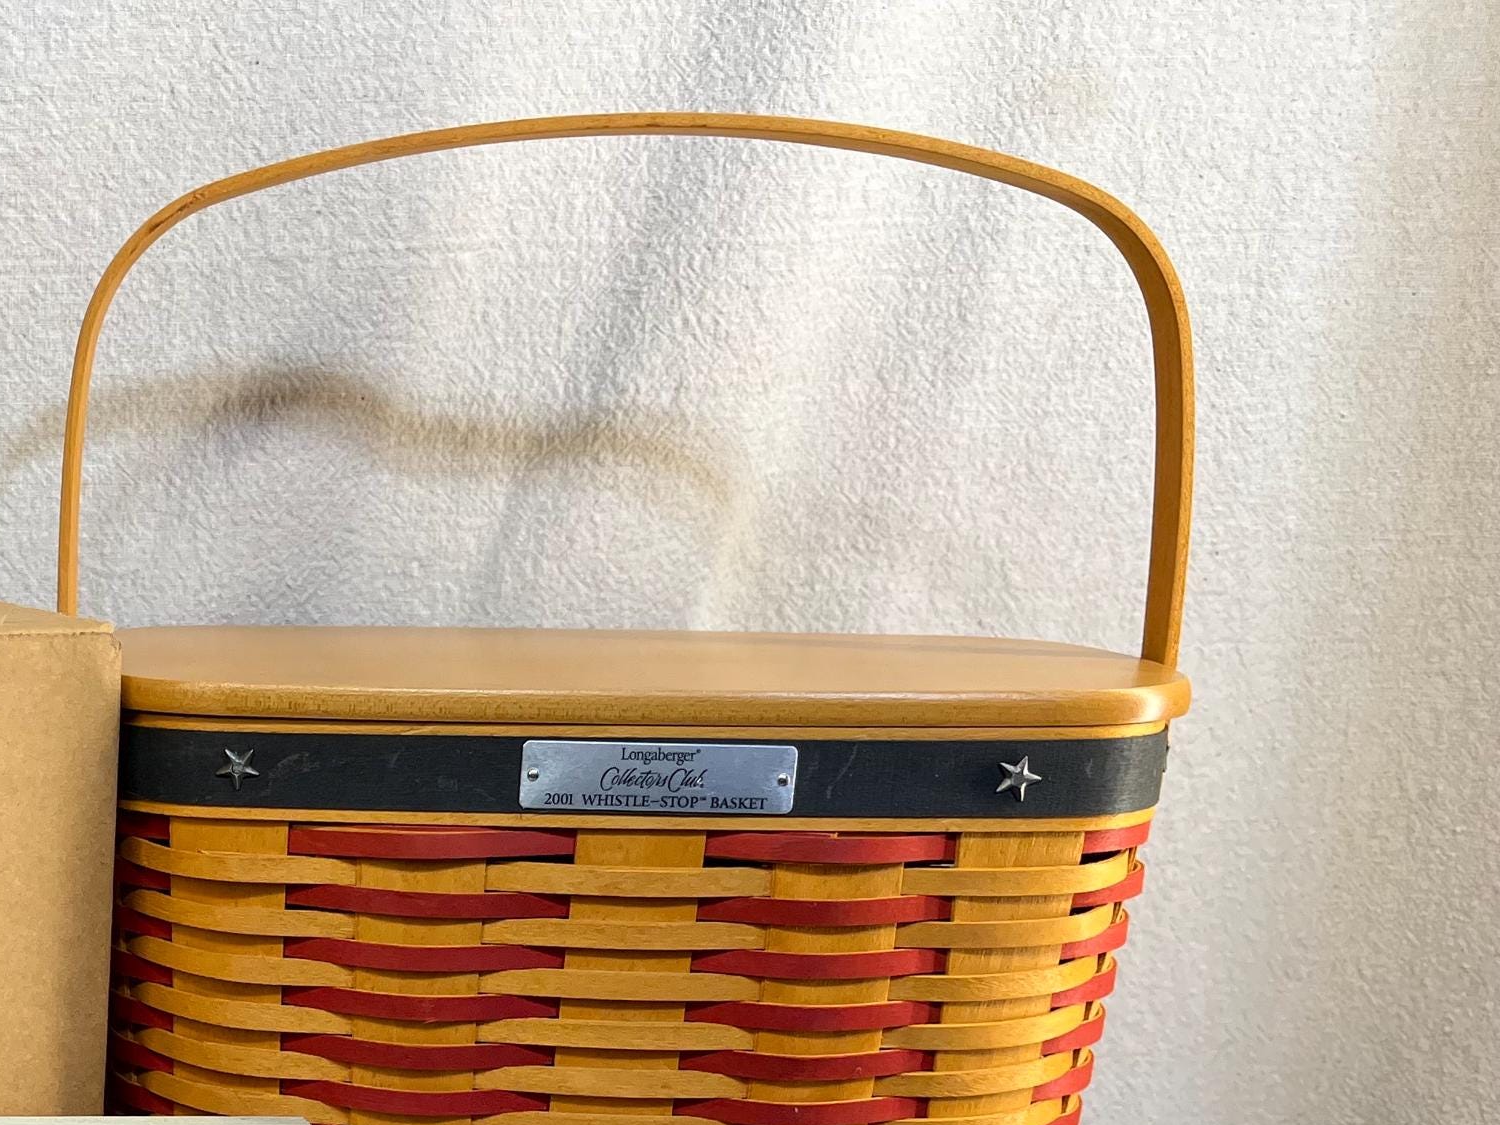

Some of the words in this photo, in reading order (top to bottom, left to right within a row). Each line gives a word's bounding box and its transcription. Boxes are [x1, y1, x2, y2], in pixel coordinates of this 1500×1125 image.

[600, 766, 668, 791] Collectors
[543, 792, 574, 806] 2001
[710, 797, 768, 810] BASKET
